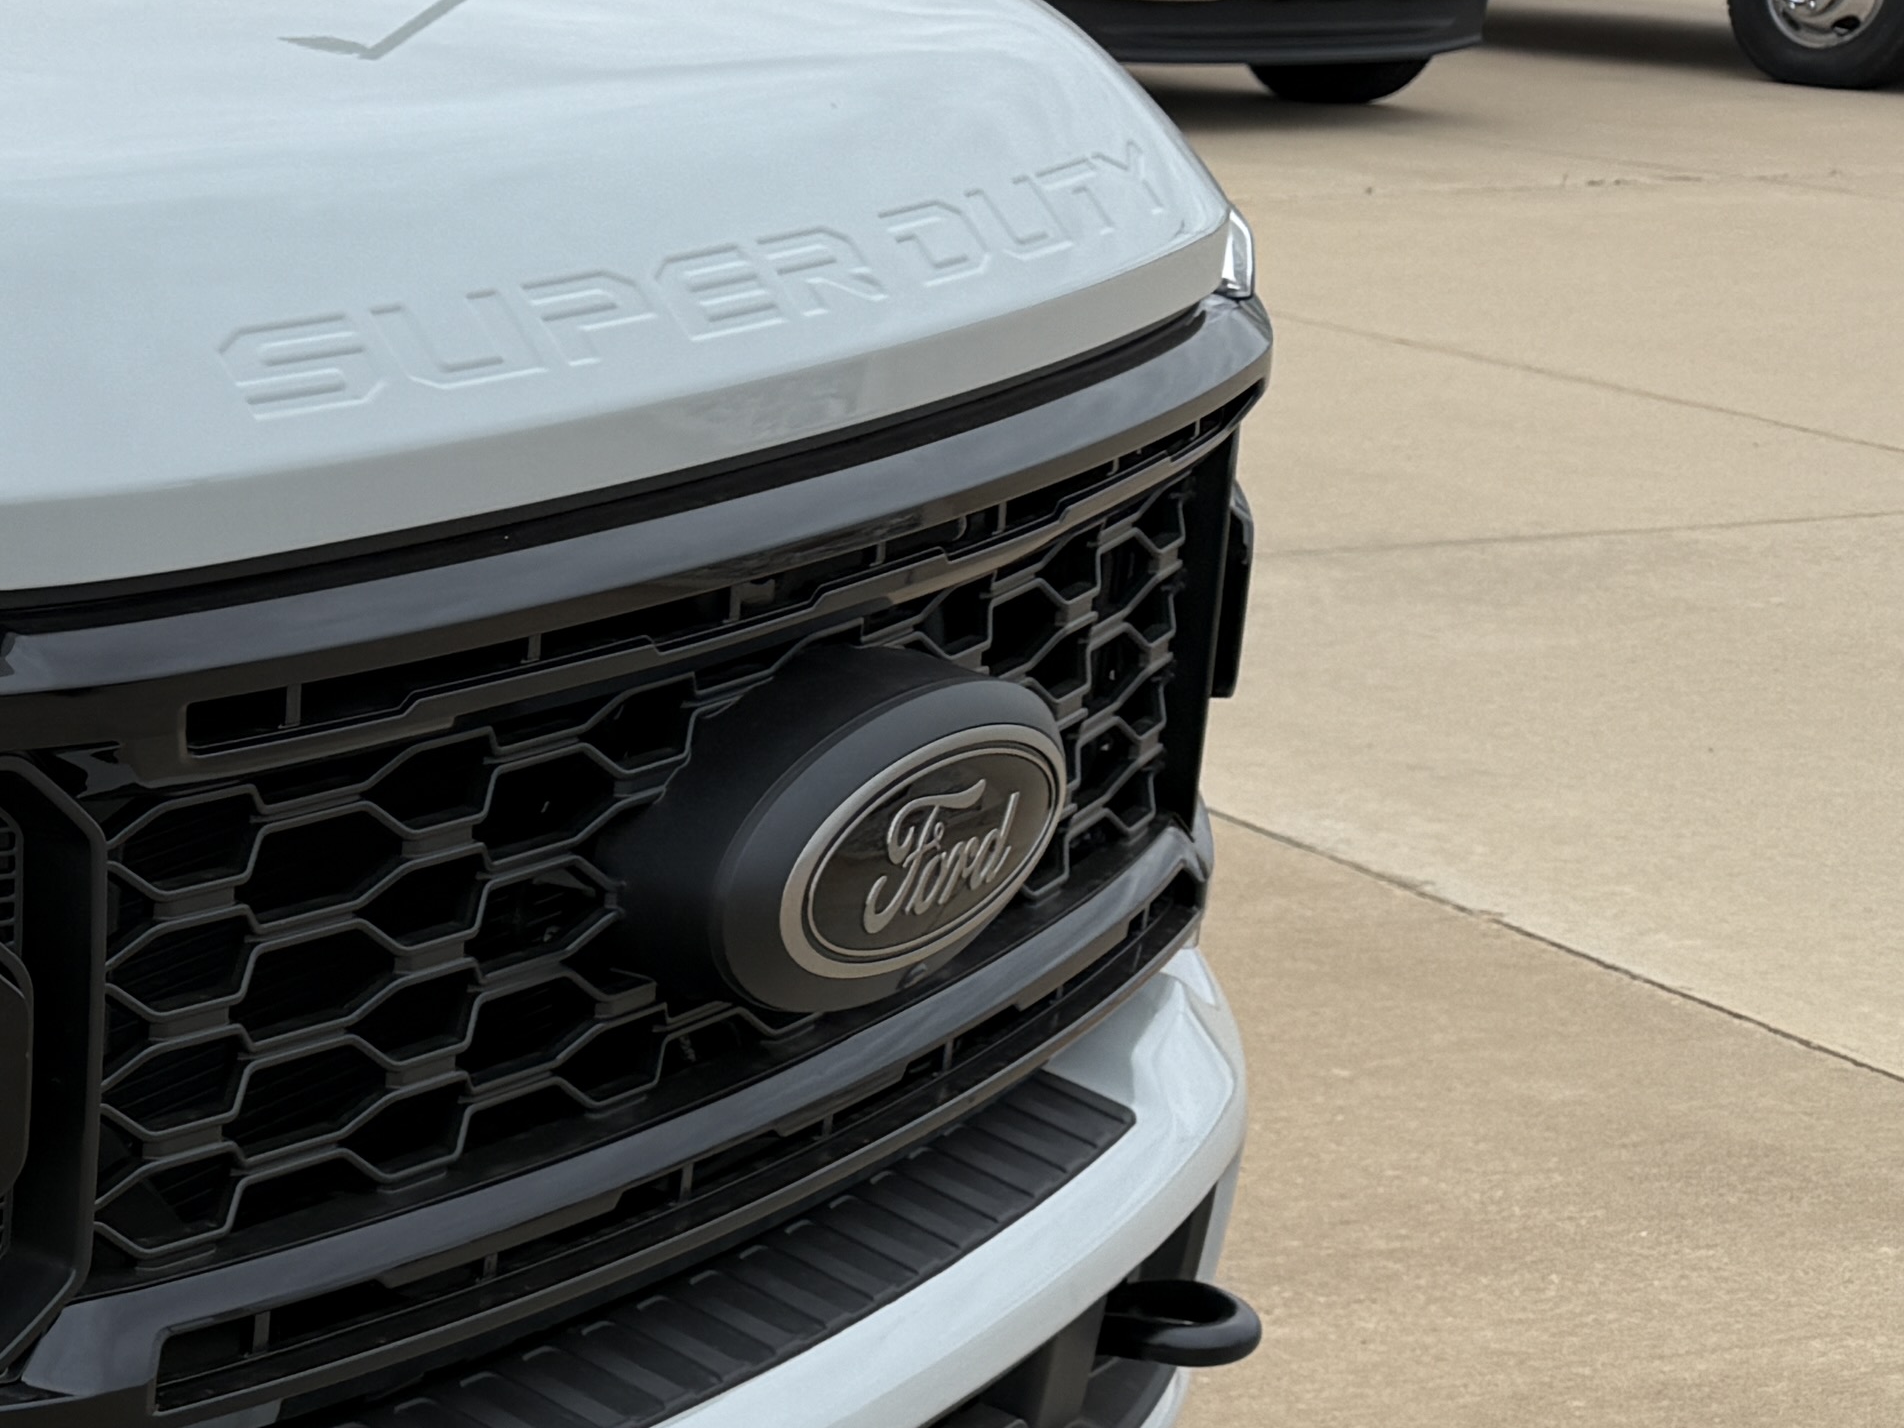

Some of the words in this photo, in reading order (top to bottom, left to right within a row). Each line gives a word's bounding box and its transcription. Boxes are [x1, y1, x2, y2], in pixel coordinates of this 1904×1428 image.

[214, 220, 890, 422] SUPER
[875, 139, 1172, 290] DUTY
[863, 778, 1021, 934] Ford
